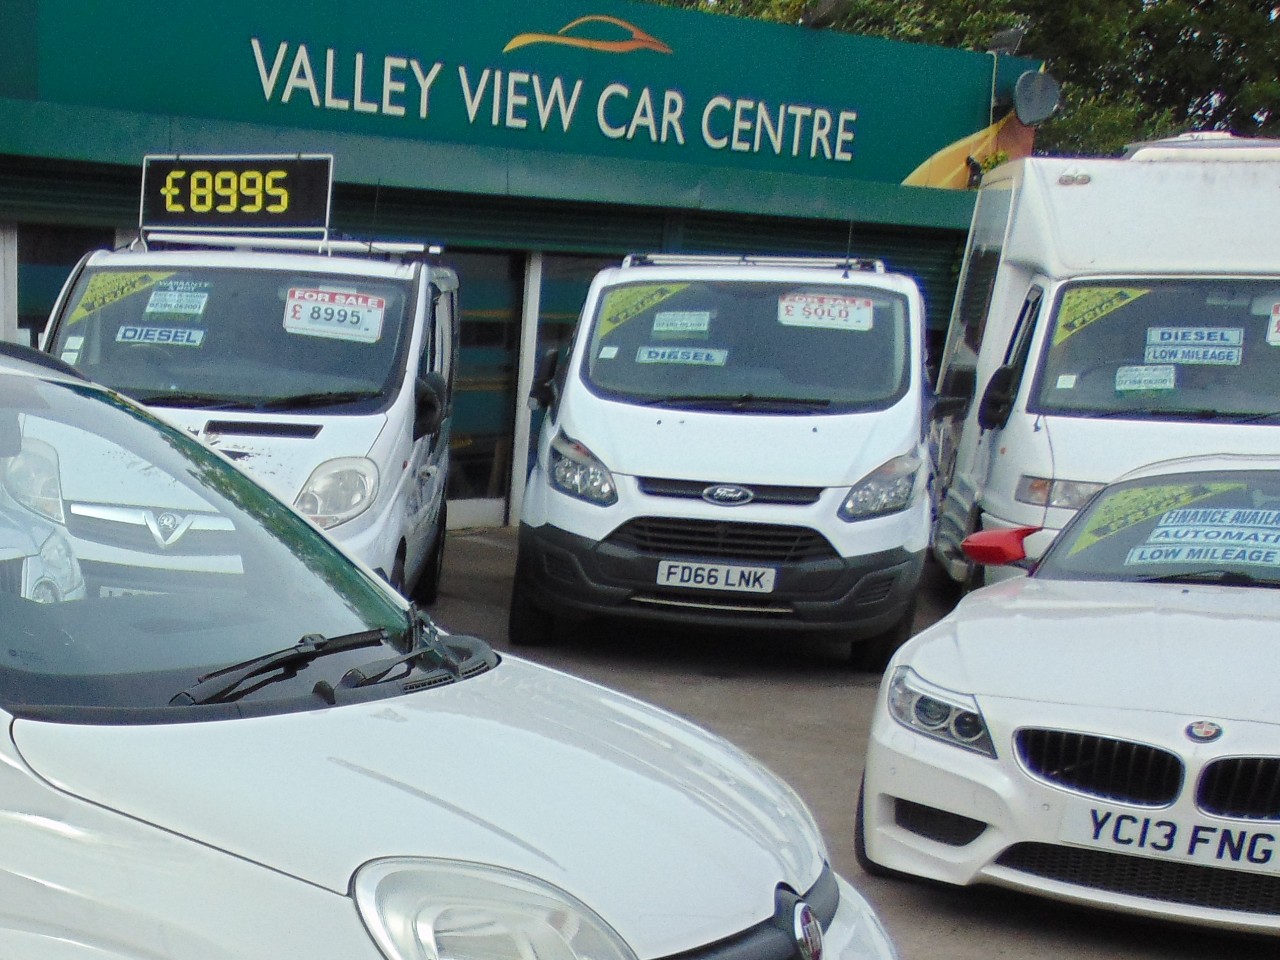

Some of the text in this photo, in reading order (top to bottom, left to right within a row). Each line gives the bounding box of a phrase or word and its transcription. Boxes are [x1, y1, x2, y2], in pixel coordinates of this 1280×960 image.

[250, 37, 857, 161] VALLEY VIEW CAR CENTRE
[160, 170, 288, 212] £8995
[295, 291, 379, 308] FOR SALE
[310, 306, 361, 325] 8995
[122, 328, 197, 343] DIESEL
[1160, 331, 1230, 342] DIESEL
[647, 350, 715, 362] DIESEL
[1153, 351, 1234, 361] LOW MILEAGE
[714, 487, 743, 499] Ford
[1164, 510, 1230, 523] FINANCE
[1138, 548, 1277, 562] LOW MILEAGE
[666, 565, 766, 588] FD66 LNK
[1090, 809, 1275, 864] YC13 FNG
